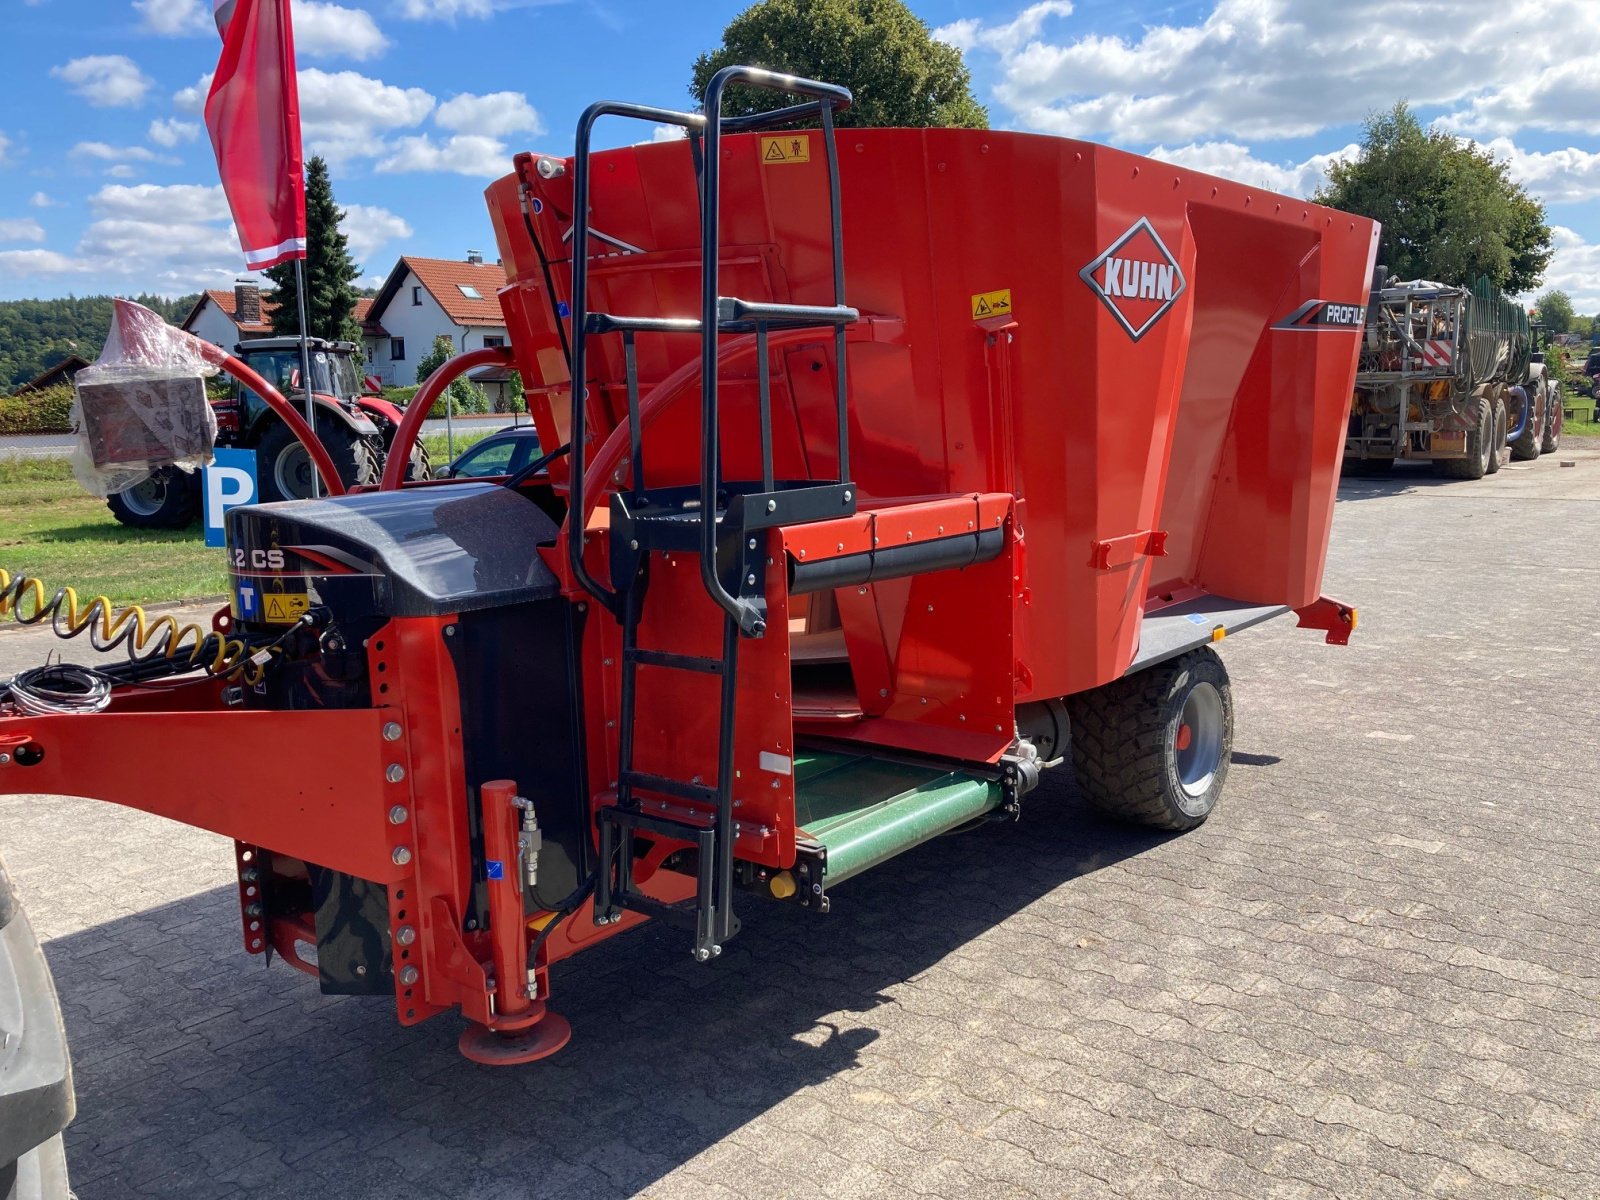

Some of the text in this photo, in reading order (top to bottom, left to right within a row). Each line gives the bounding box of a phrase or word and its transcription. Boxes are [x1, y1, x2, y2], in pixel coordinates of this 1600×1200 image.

[1104, 257, 1174, 300] KUHN
[1326, 304, 1364, 324] PROFILE
[207, 466, 254, 528] P
[251, 549, 285, 568] CS
[240, 587, 254, 610] T
